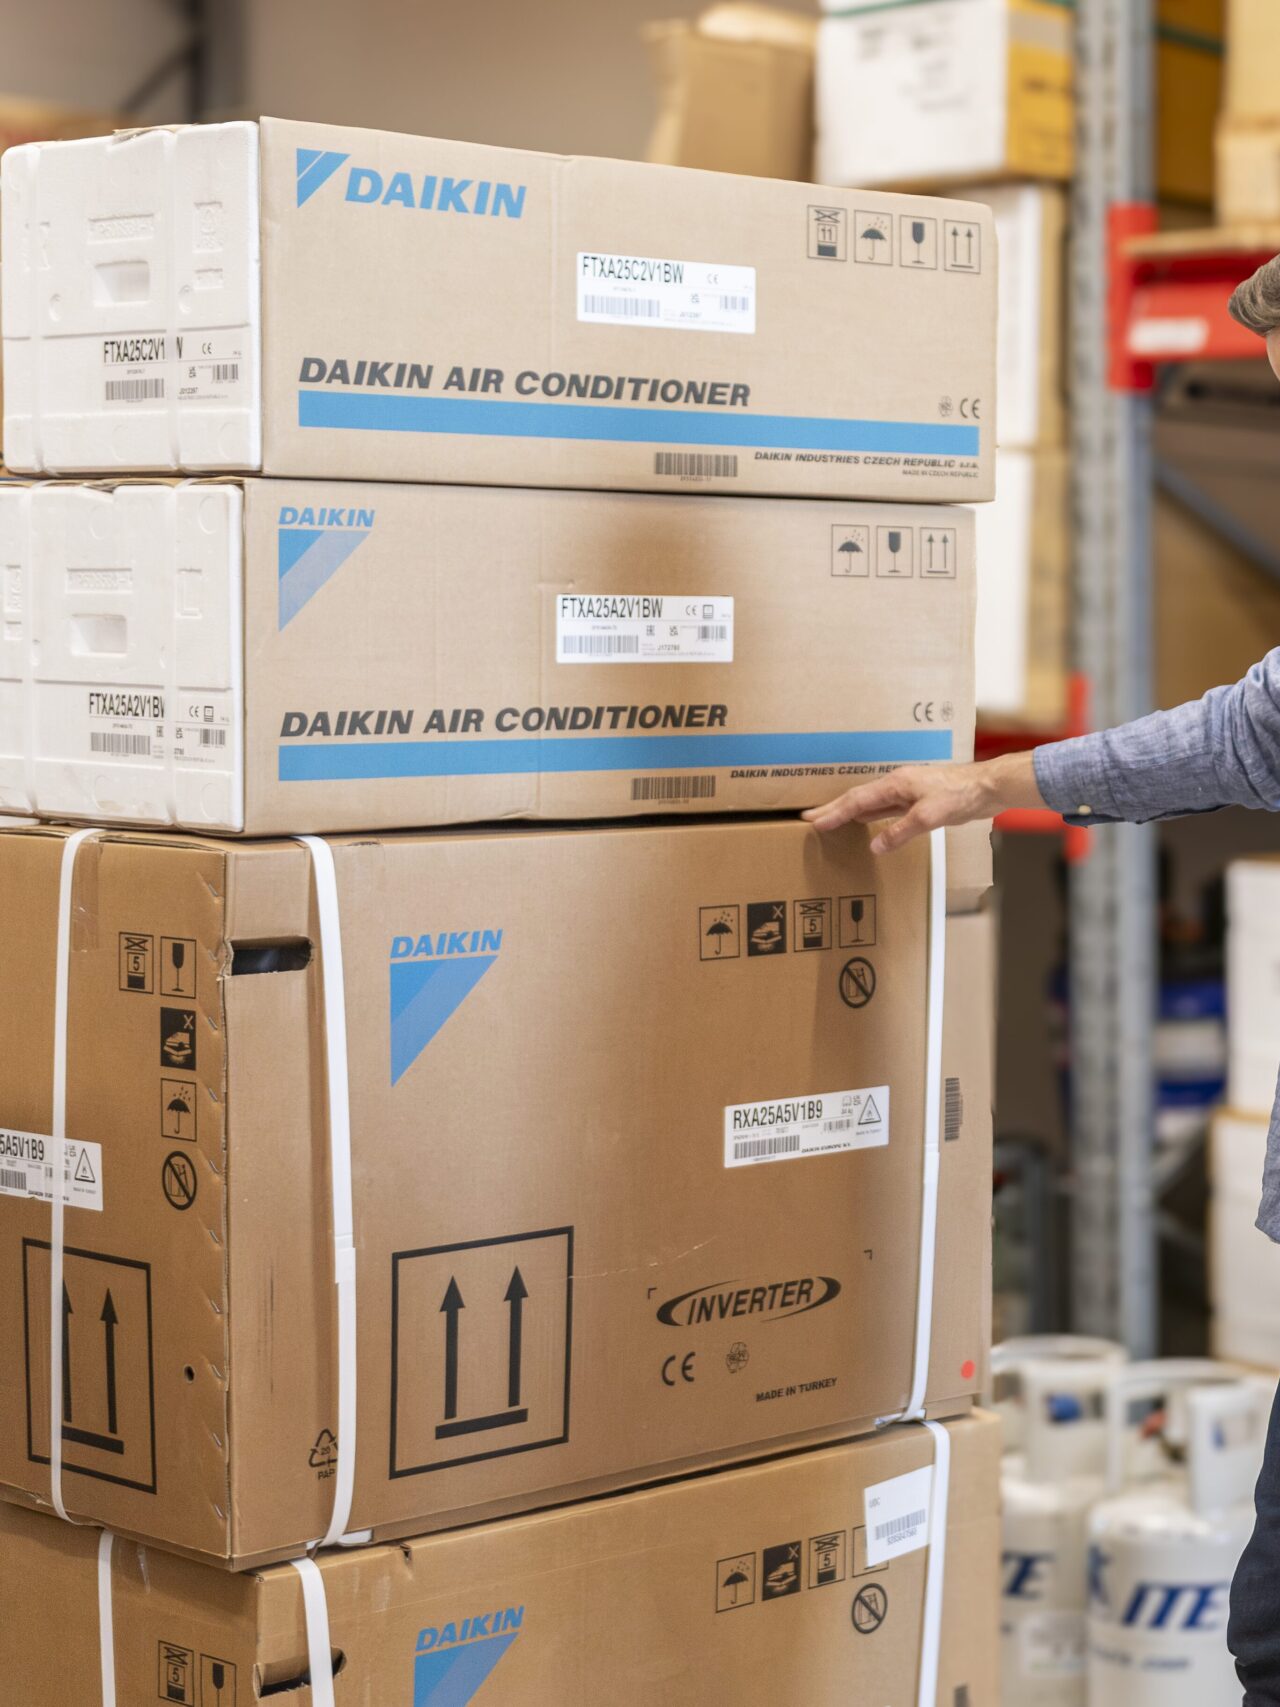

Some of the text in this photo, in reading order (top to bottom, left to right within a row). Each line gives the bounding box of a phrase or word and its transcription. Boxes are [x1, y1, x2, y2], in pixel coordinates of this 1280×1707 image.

[345, 167, 527, 219] DAIKIN
[583, 256, 684, 284] FTXA25C2V1BW
[104, 336, 183, 363] FTXA25C2V1
[299, 357, 750, 407] DAIKIN AIR CONDITIONER
[754, 451, 792, 461] DAIKIN
[796, 453, 860, 465] INDUSTRIES
[863, 456, 900, 466] CZECH
[903, 457, 956, 468] REPUBLIC
[279, 507, 375, 528] DAIKIN
[562, 597, 664, 619] FTXA25A2V1BW
[280, 704, 728, 737] DAIKIN AIR CONDITIONER
[730, 769, 768, 779] DAIKIN
[771, 766, 835, 777] INDUSTRIES
[838, 765, 876, 775] CZECH
[390, 928, 503, 959] DAIKIN
[733, 1099, 823, 1130] RXA25A5V1B9
[687, 1278, 814, 1326] INVERTER
[755, 1377, 838, 1402] MADE IN TURKEY
[415, 1605, 525, 1652] DAIKIN
